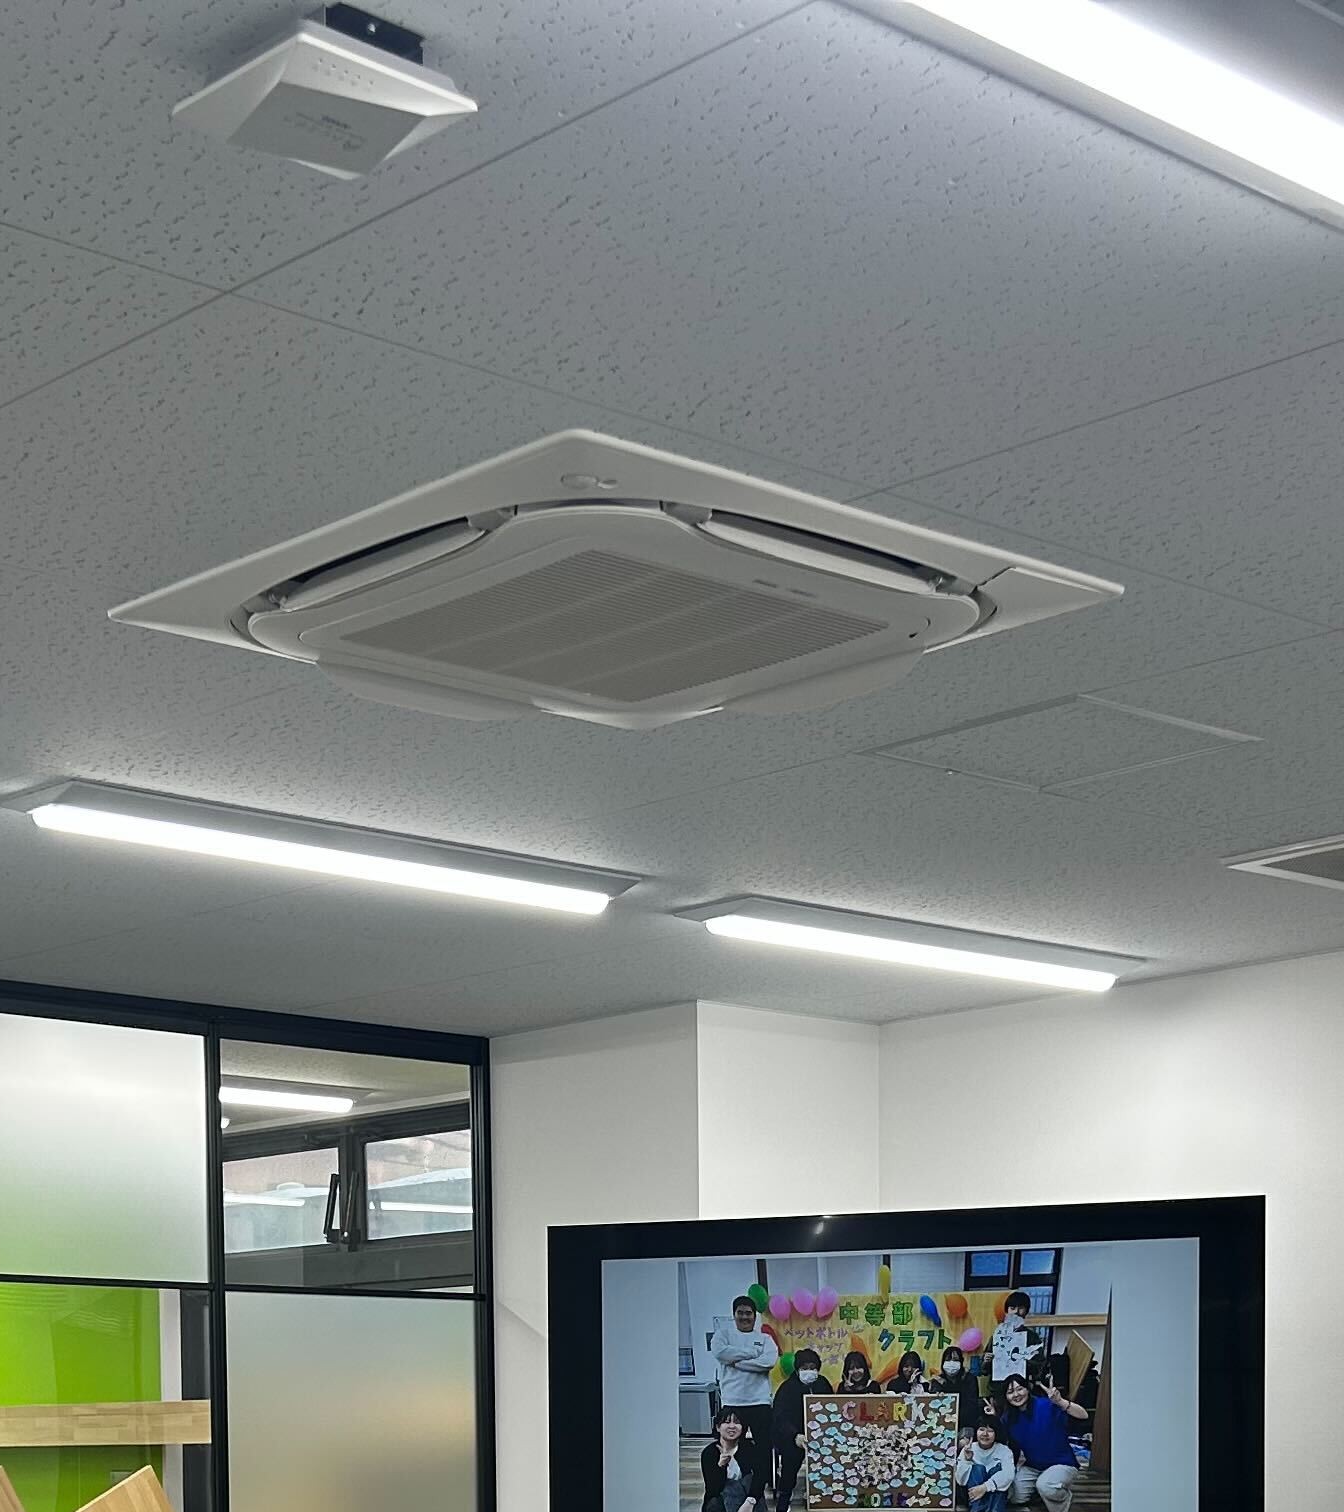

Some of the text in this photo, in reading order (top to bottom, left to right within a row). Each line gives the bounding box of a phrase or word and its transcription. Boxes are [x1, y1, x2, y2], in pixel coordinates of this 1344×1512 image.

[839, 1301, 914, 1326] 中等部
[877, 1328, 953, 1352] クラフト
[842, 1400, 926, 1422] CLARK
